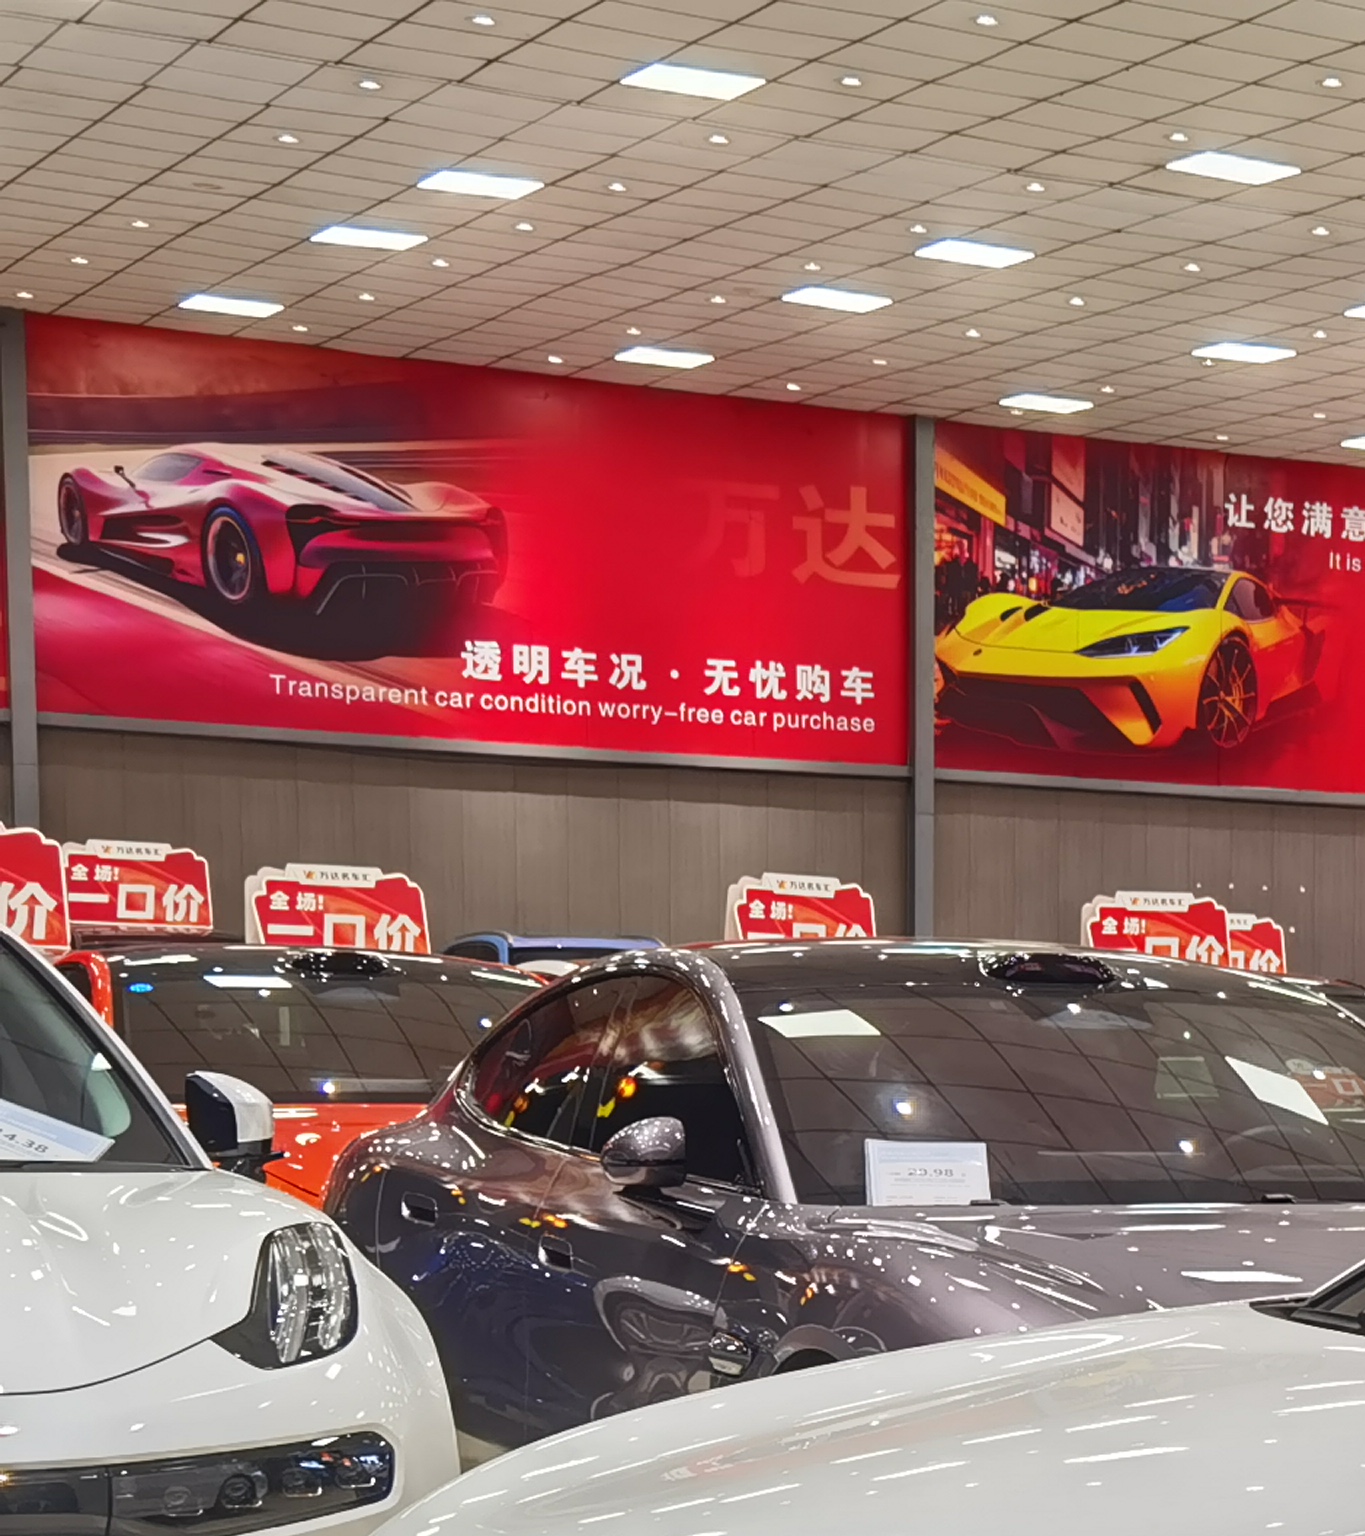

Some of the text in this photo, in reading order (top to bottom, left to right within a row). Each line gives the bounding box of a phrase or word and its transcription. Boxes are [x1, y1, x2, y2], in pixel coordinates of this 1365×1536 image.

[1329, 552, 1341, 571] It
[1346, 554, 1361, 573] is
[269, 673, 429, 706] Transparent
[435, 690, 474, 709] car
[480, 692, 591, 717] condition
[730, 707, 767, 726] car
[772, 711, 876, 733] purchase
[69, 883, 205, 923] 一口价
[269, 890, 325, 912] 全场!
[267, 913, 421, 951] 一口价
[0, 1128, 49, 1154] 4.38
